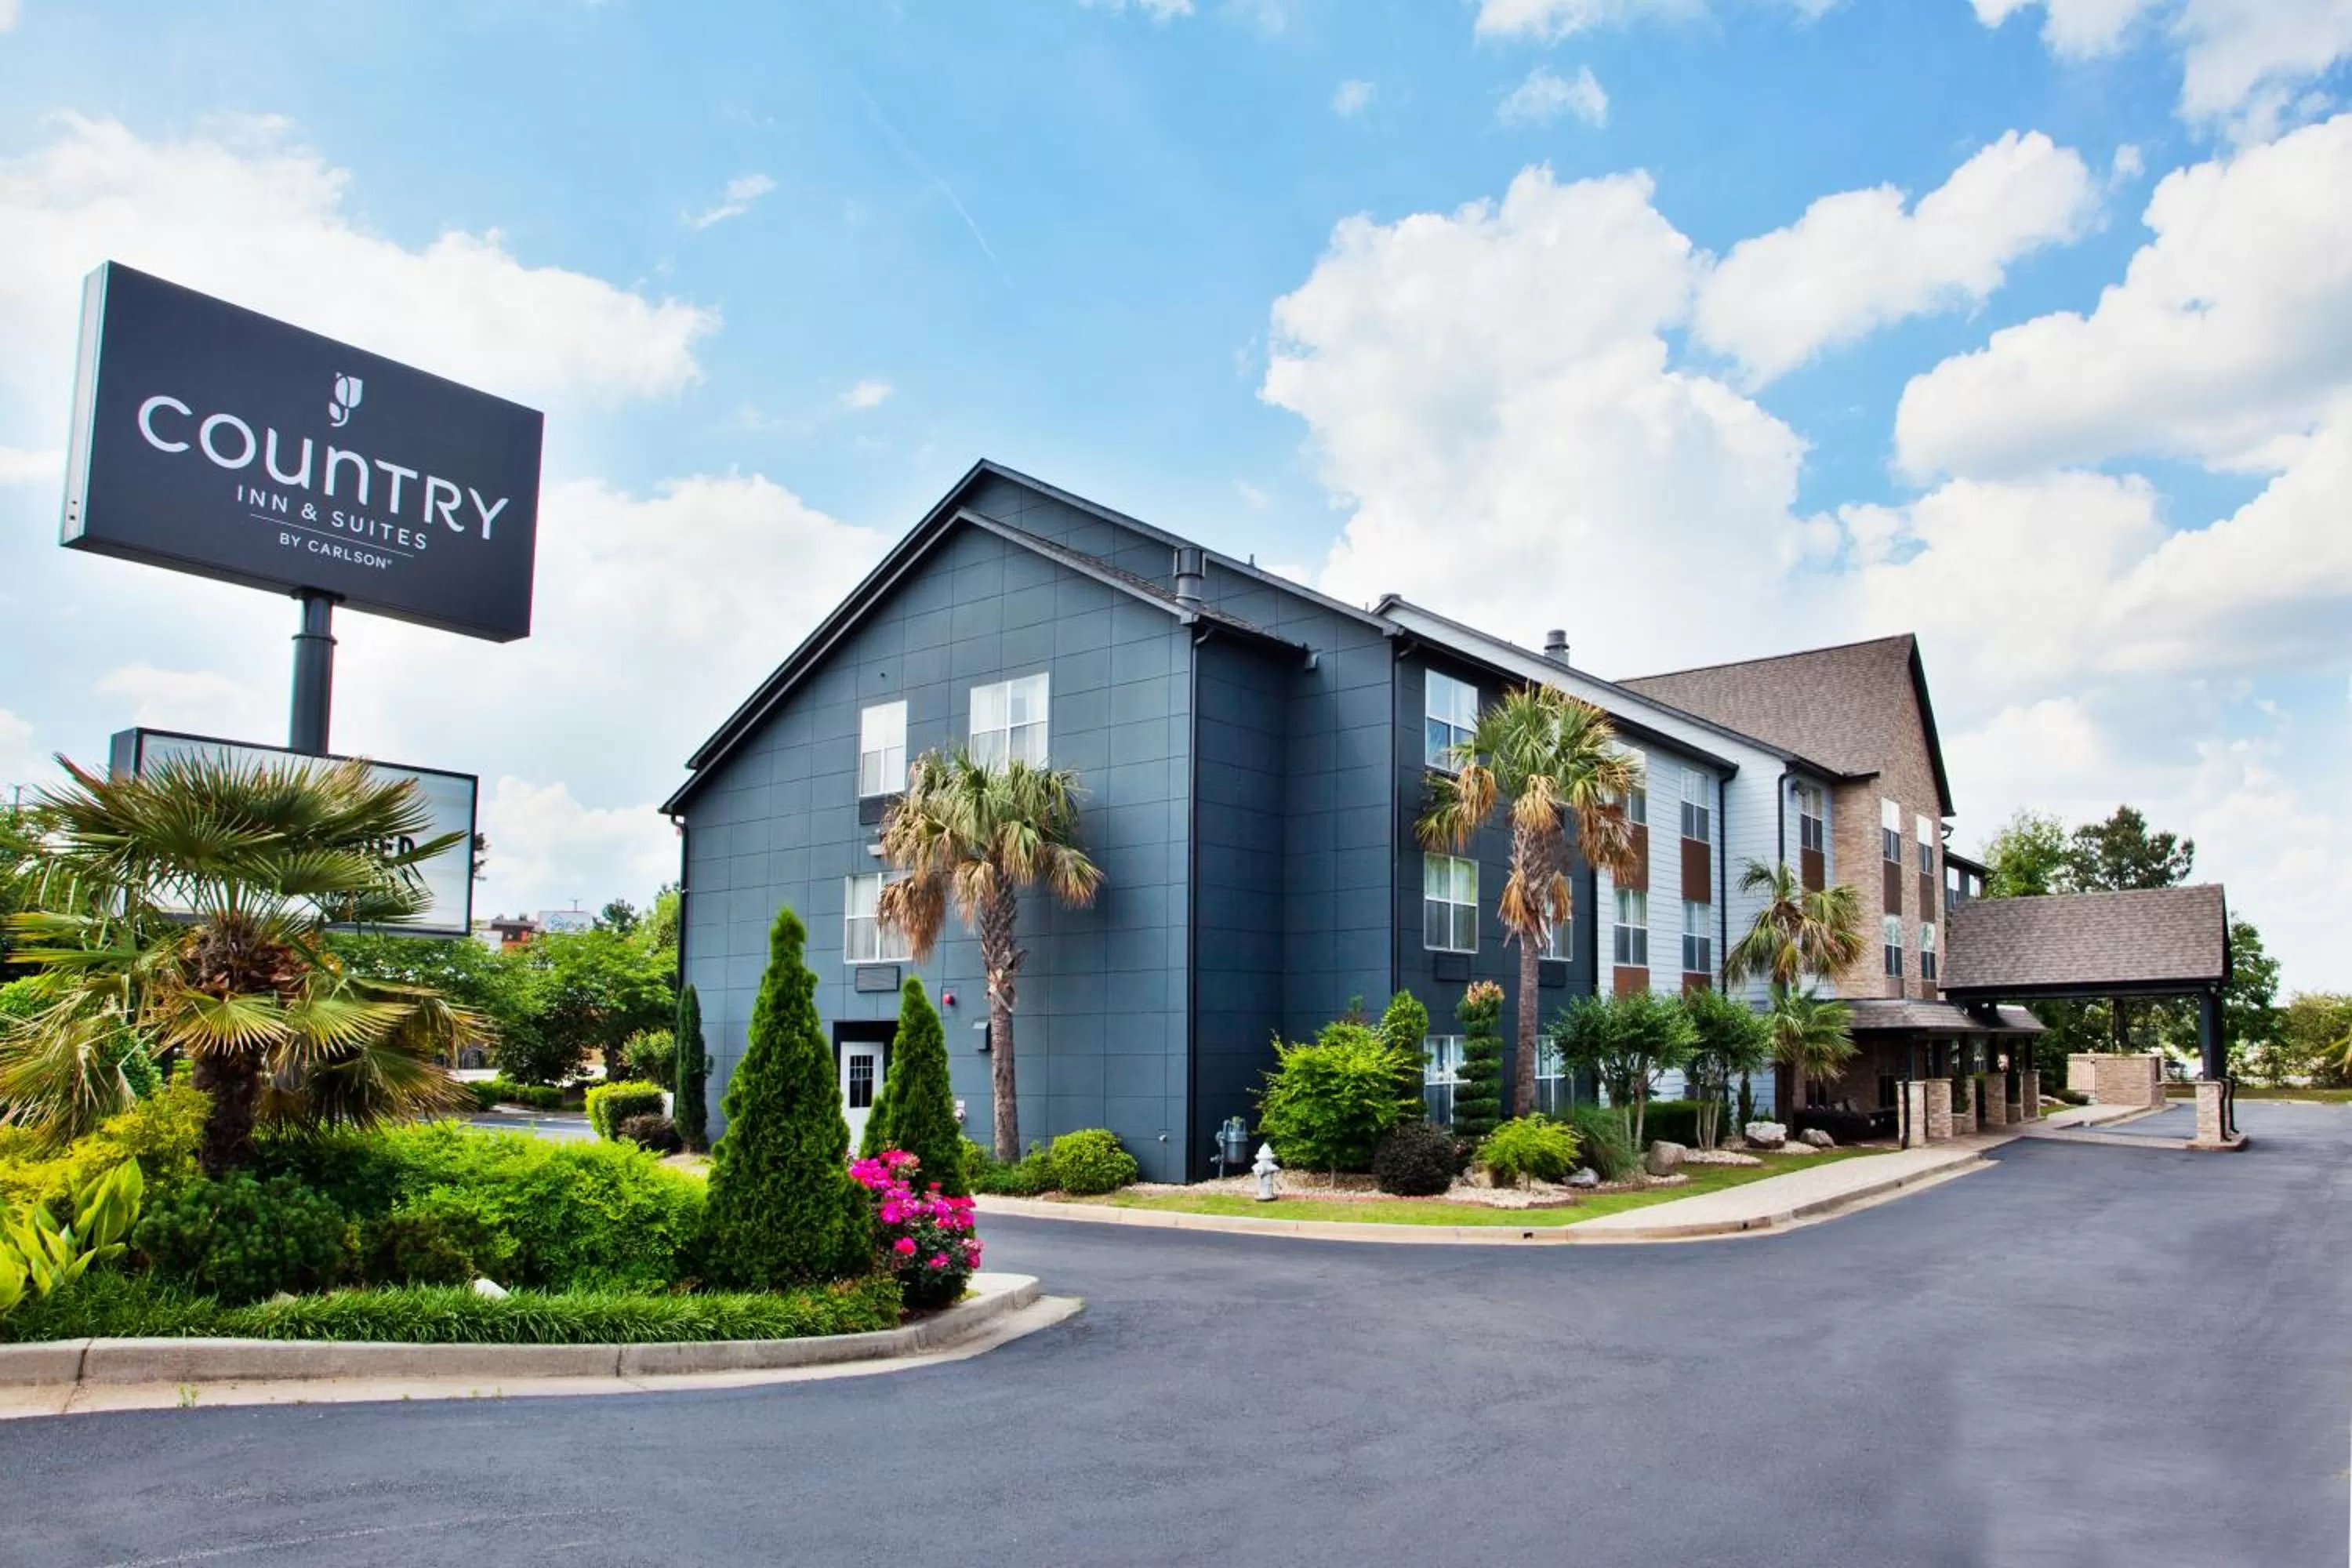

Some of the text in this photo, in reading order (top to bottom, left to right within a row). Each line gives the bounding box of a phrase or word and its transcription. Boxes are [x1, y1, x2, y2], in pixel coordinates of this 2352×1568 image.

[237, 485, 427, 550] INN & SUITES
[279, 532, 301, 547] BY
